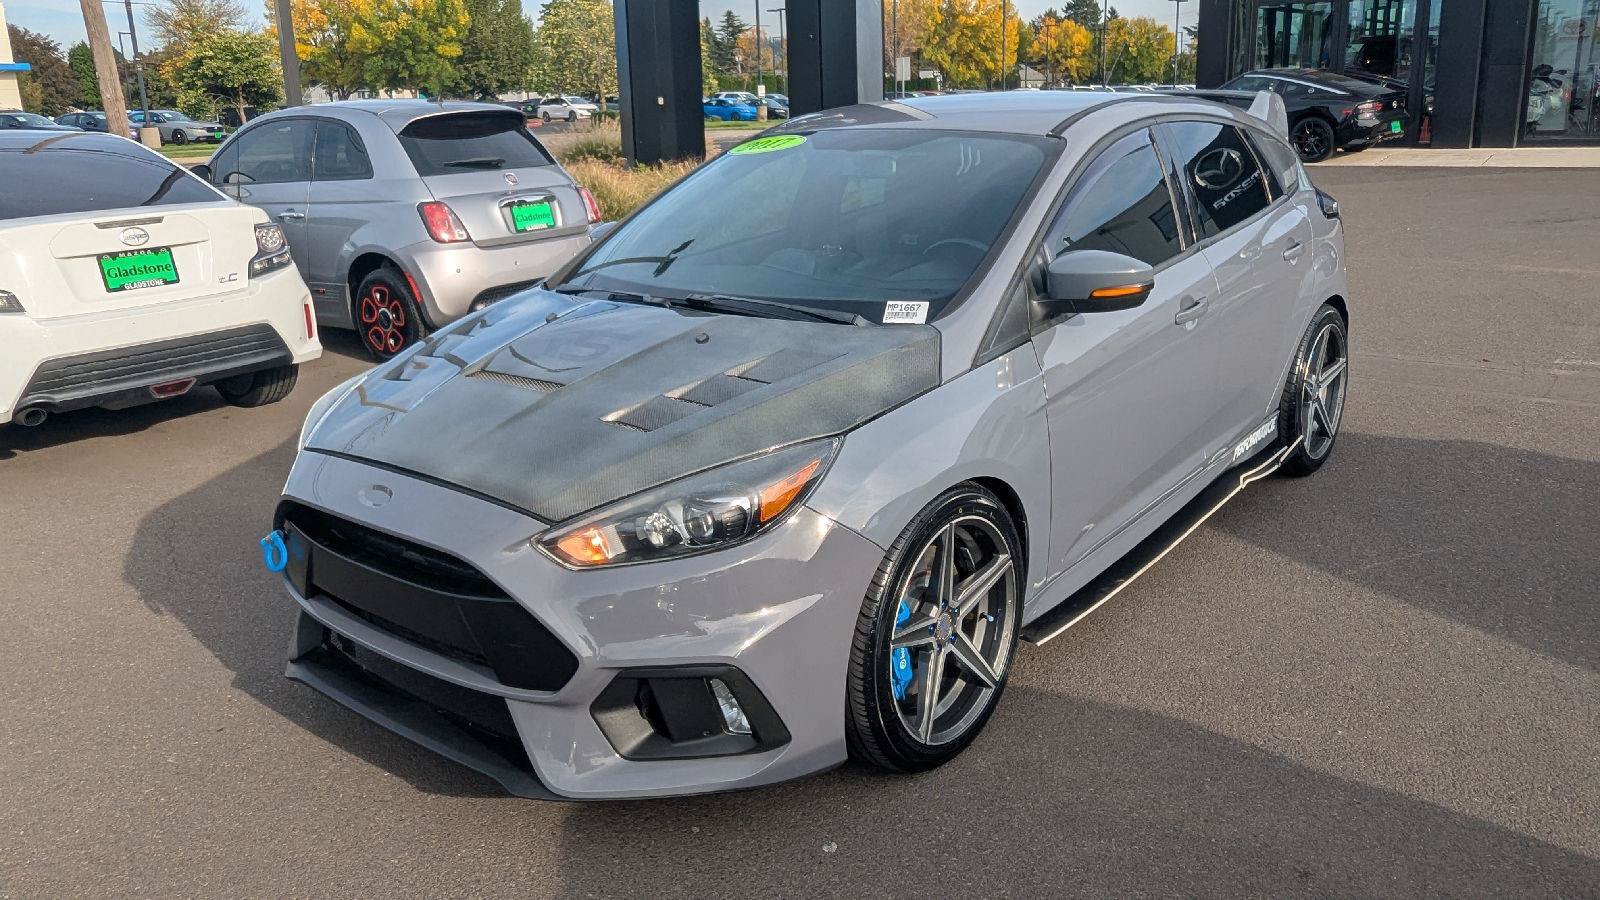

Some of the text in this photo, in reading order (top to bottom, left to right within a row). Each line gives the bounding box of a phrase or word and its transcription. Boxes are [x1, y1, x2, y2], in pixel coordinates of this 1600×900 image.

[118, 249, 153, 258] MAZDA
[106, 262, 172, 279] Gladstone
[124, 279, 165, 290] GLADSTONE
[887, 303, 922, 312] MP1667
